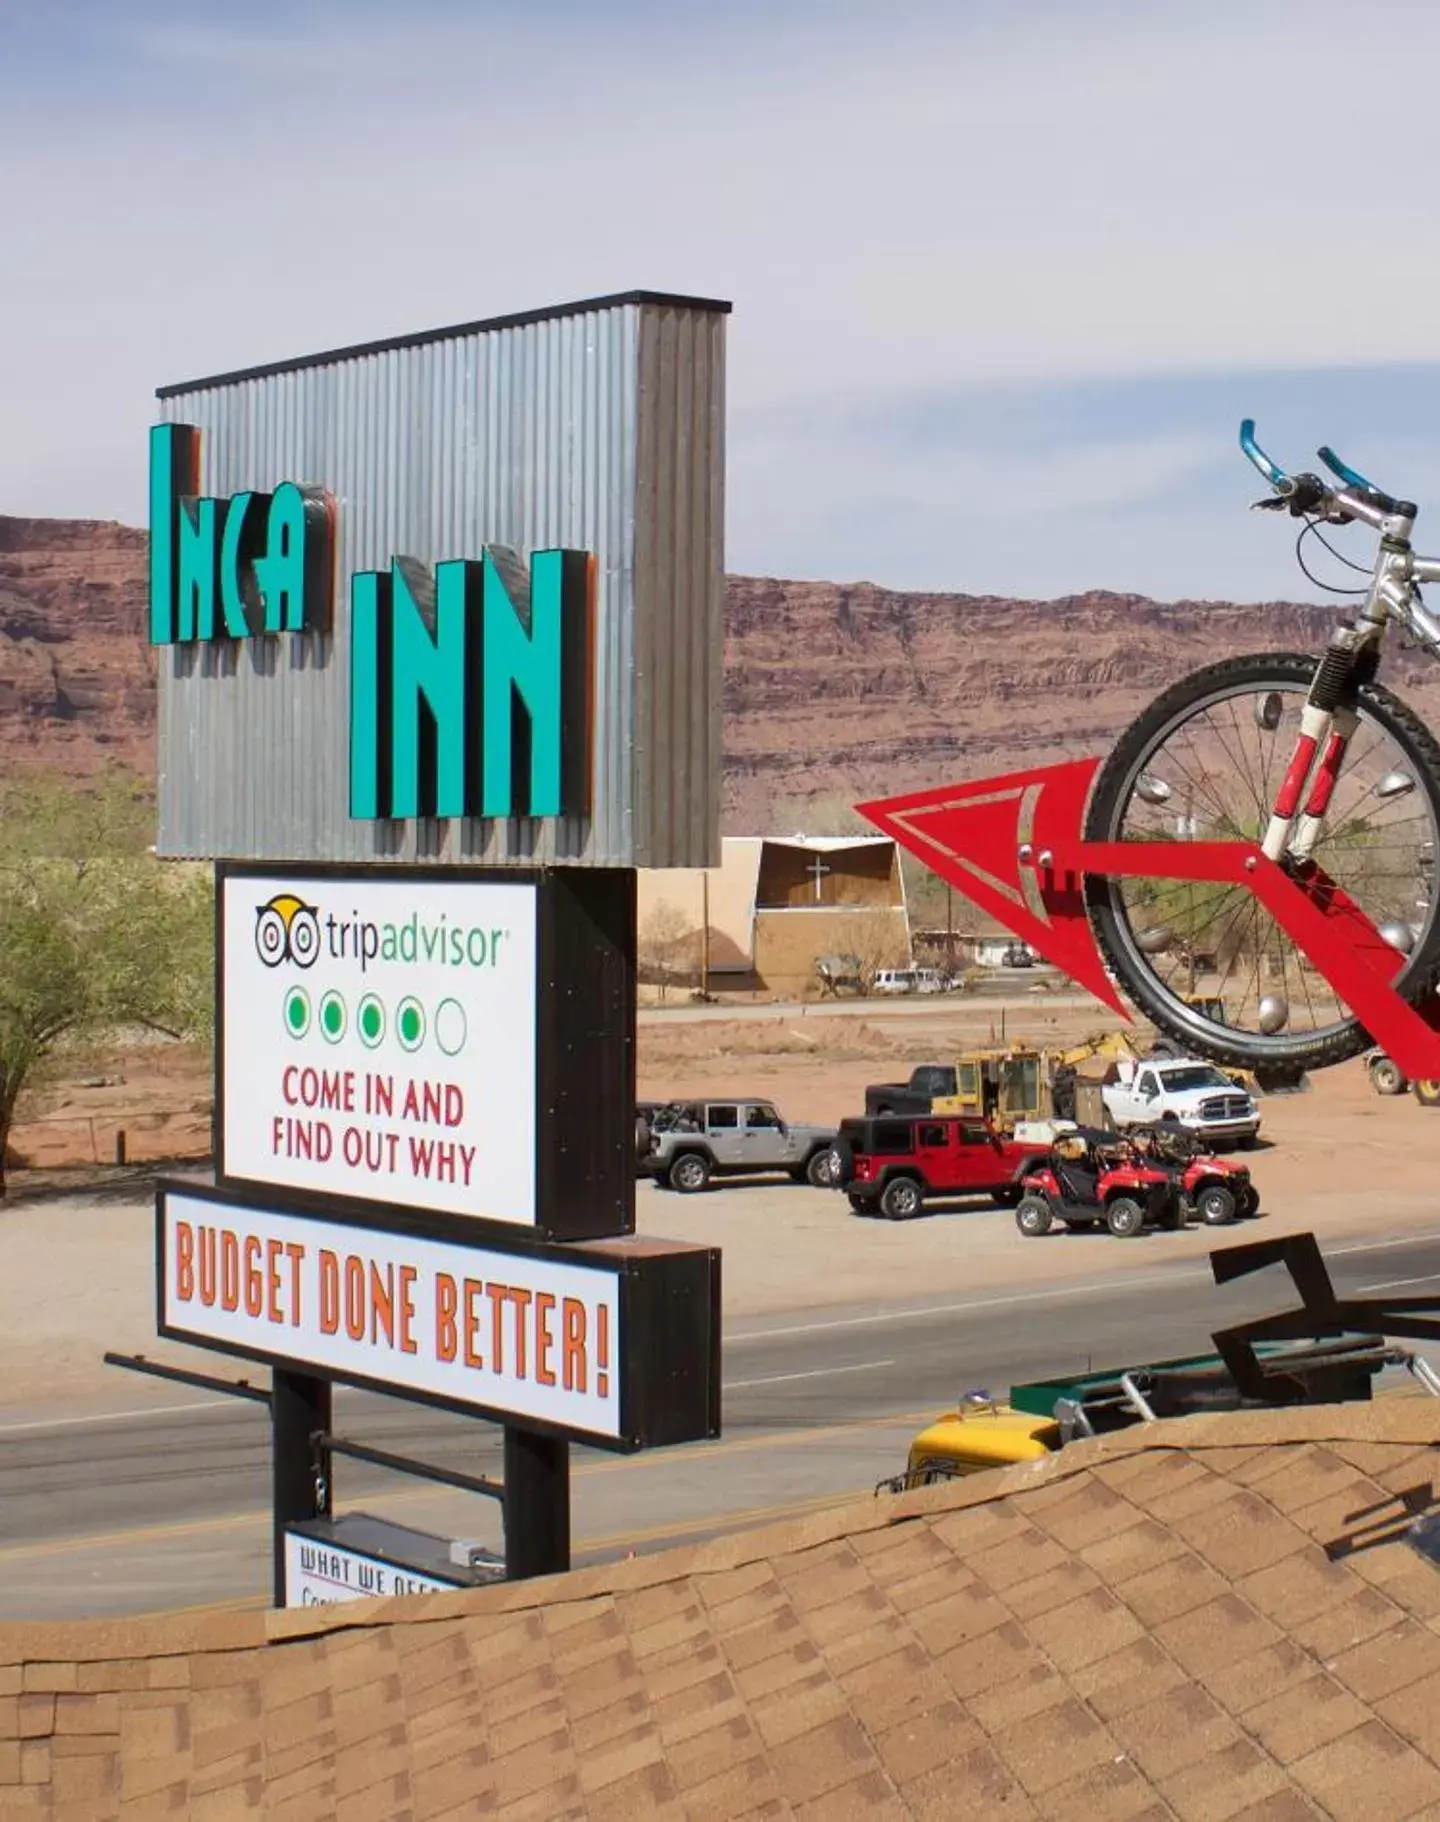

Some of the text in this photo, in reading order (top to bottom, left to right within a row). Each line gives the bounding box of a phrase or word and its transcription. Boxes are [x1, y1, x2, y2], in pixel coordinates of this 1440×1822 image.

[350, 542, 562, 820] INN
[326, 909, 504, 973] tripadvisor
[282, 1065, 465, 1128] COME IN AND
[272, 1117, 477, 1186] FIND OUT WHY
[175, 1220, 609, 1400] BUDGET DONE BETTER!
[300, 1546, 350, 1582] WHAT
[358, 1562, 385, 1594] WE
